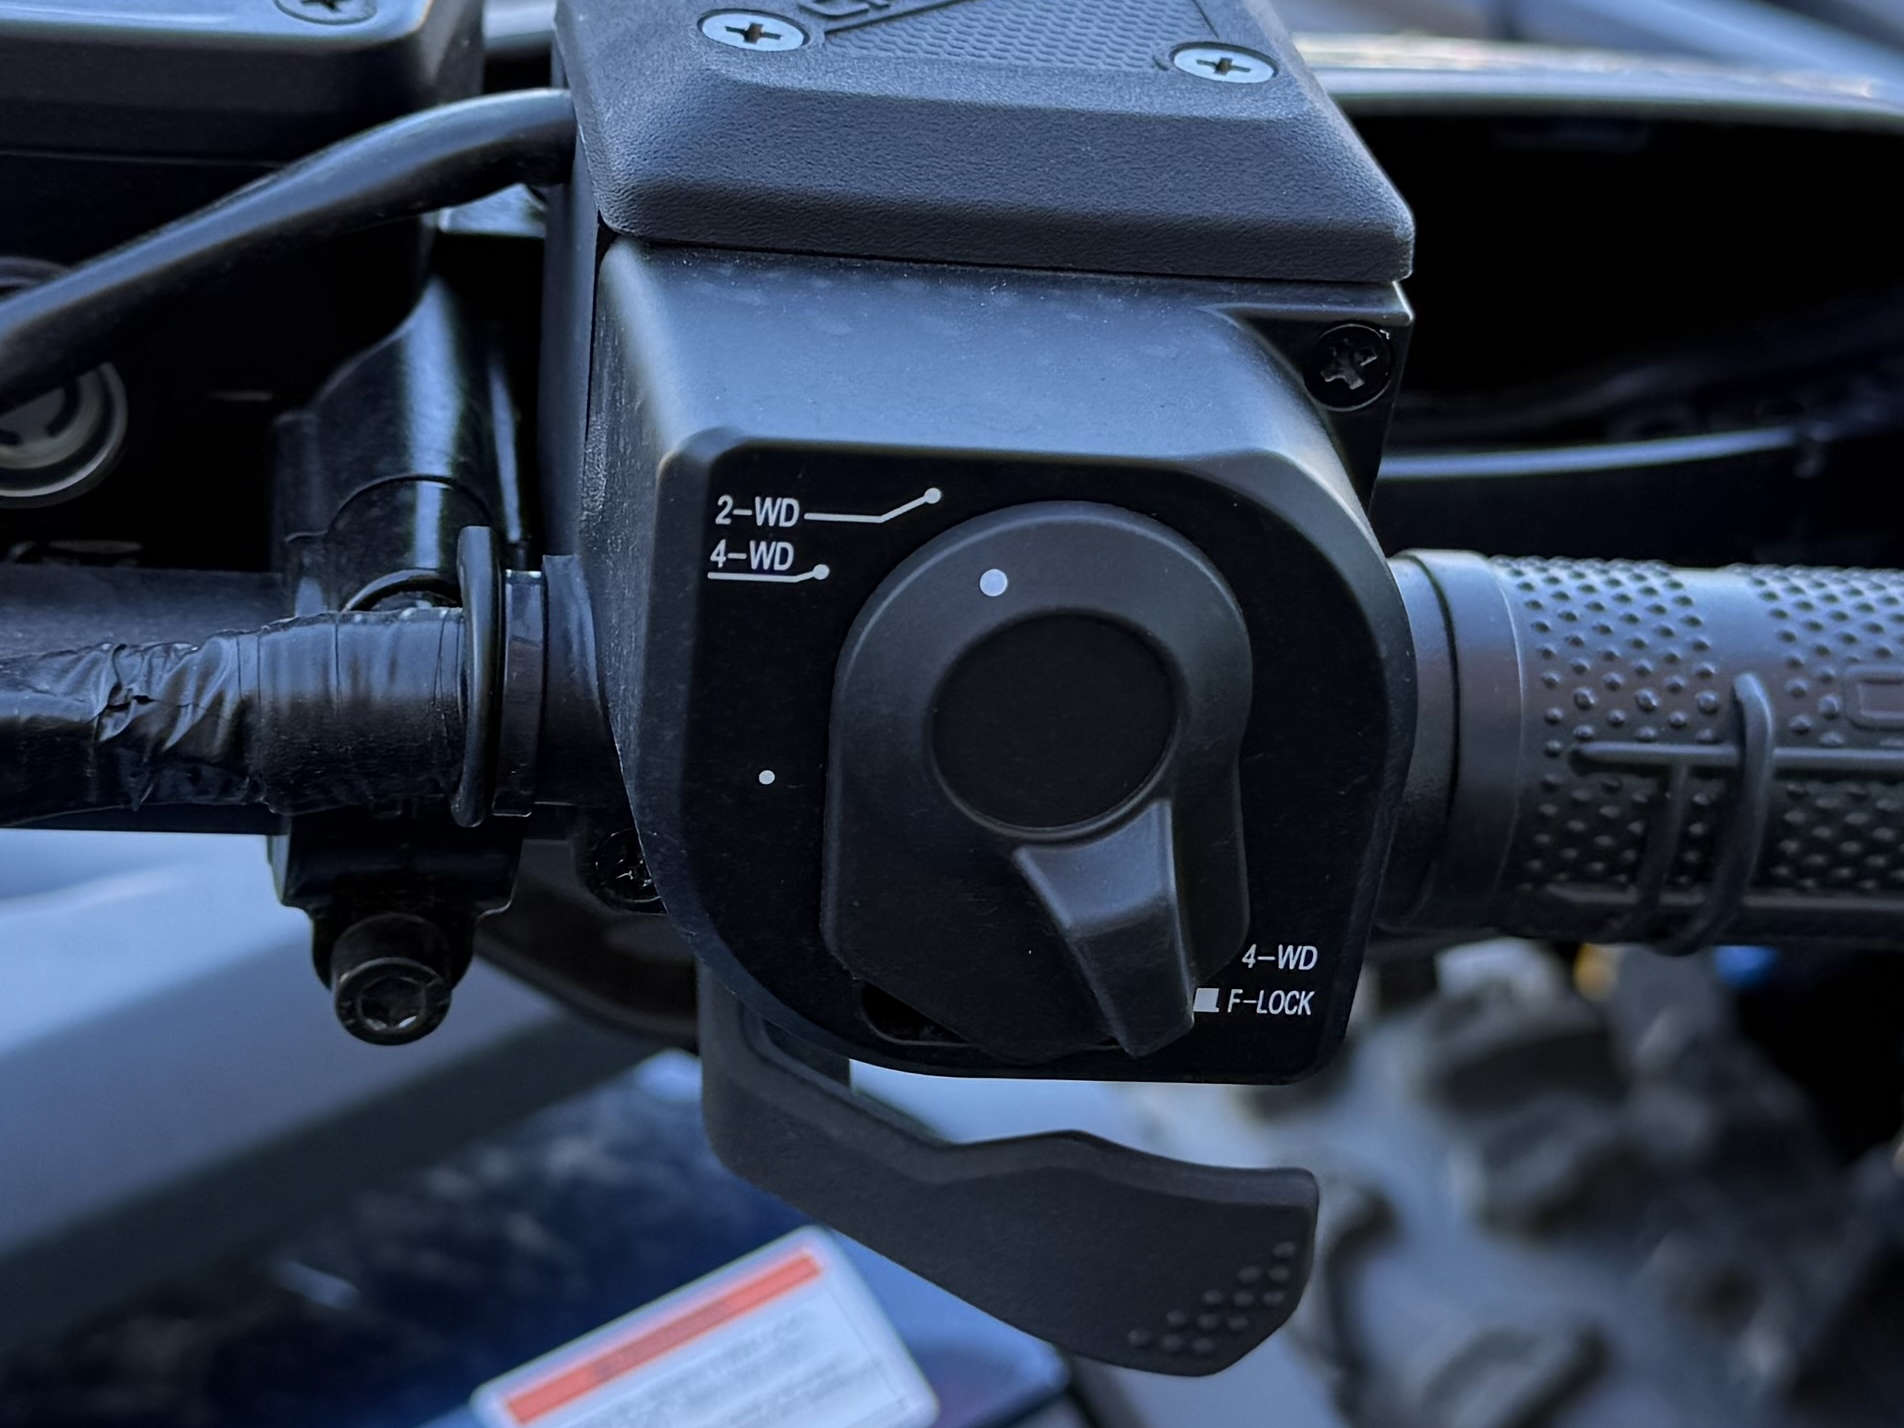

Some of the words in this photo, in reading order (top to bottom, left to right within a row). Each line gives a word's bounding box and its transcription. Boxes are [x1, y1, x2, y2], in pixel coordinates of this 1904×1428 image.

[715, 495, 801, 529] 2-WD
[709, 538, 795, 571] 4-WD
[1241, 944, 1319, 971] 4-WD
[1226, 989, 1314, 1016] F-LOCK
